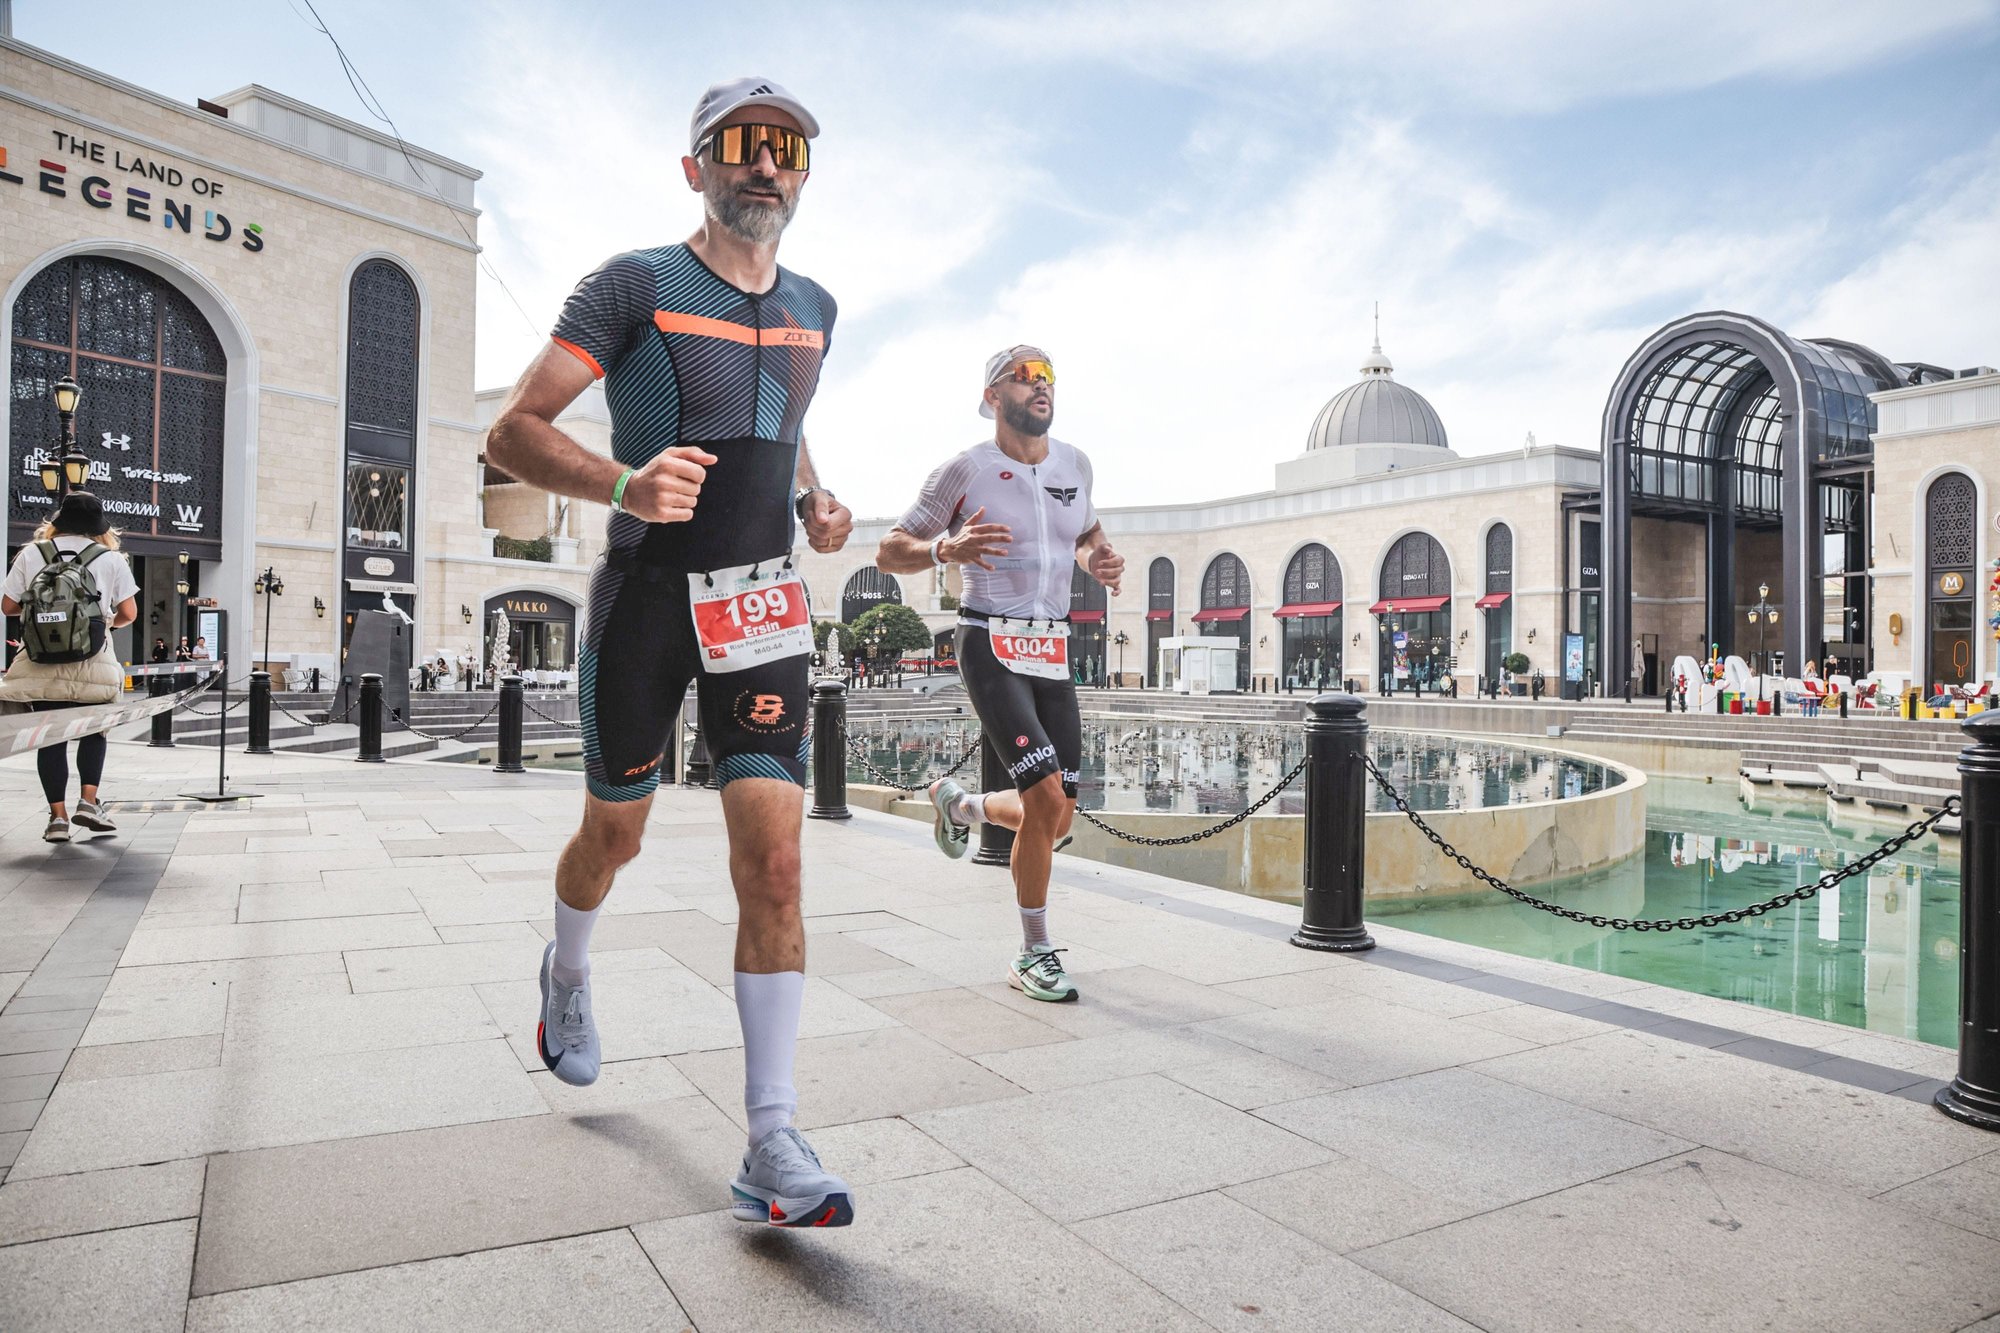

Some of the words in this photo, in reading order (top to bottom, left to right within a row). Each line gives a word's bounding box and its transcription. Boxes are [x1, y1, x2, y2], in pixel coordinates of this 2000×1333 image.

[52, 130, 105, 164] THE
[115, 151, 183, 187] LAND
[191, 177, 224, 198] OF
[0, 147, 264, 252] LEGENDS
[176, 504, 202, 523] W
[1582, 566, 1599, 576] GIZIA
[1943, 576, 1959, 588] M
[862, 592, 882, 600] BOSS
[507, 600, 548, 613] VAKKO
[725, 588, 789, 627] 199
[742, 621, 780, 638] Ersin
[745, 634, 786, 647] Performance
[1002, 637, 1056, 656] 1004
[754, 642, 783, 656] M40-44
